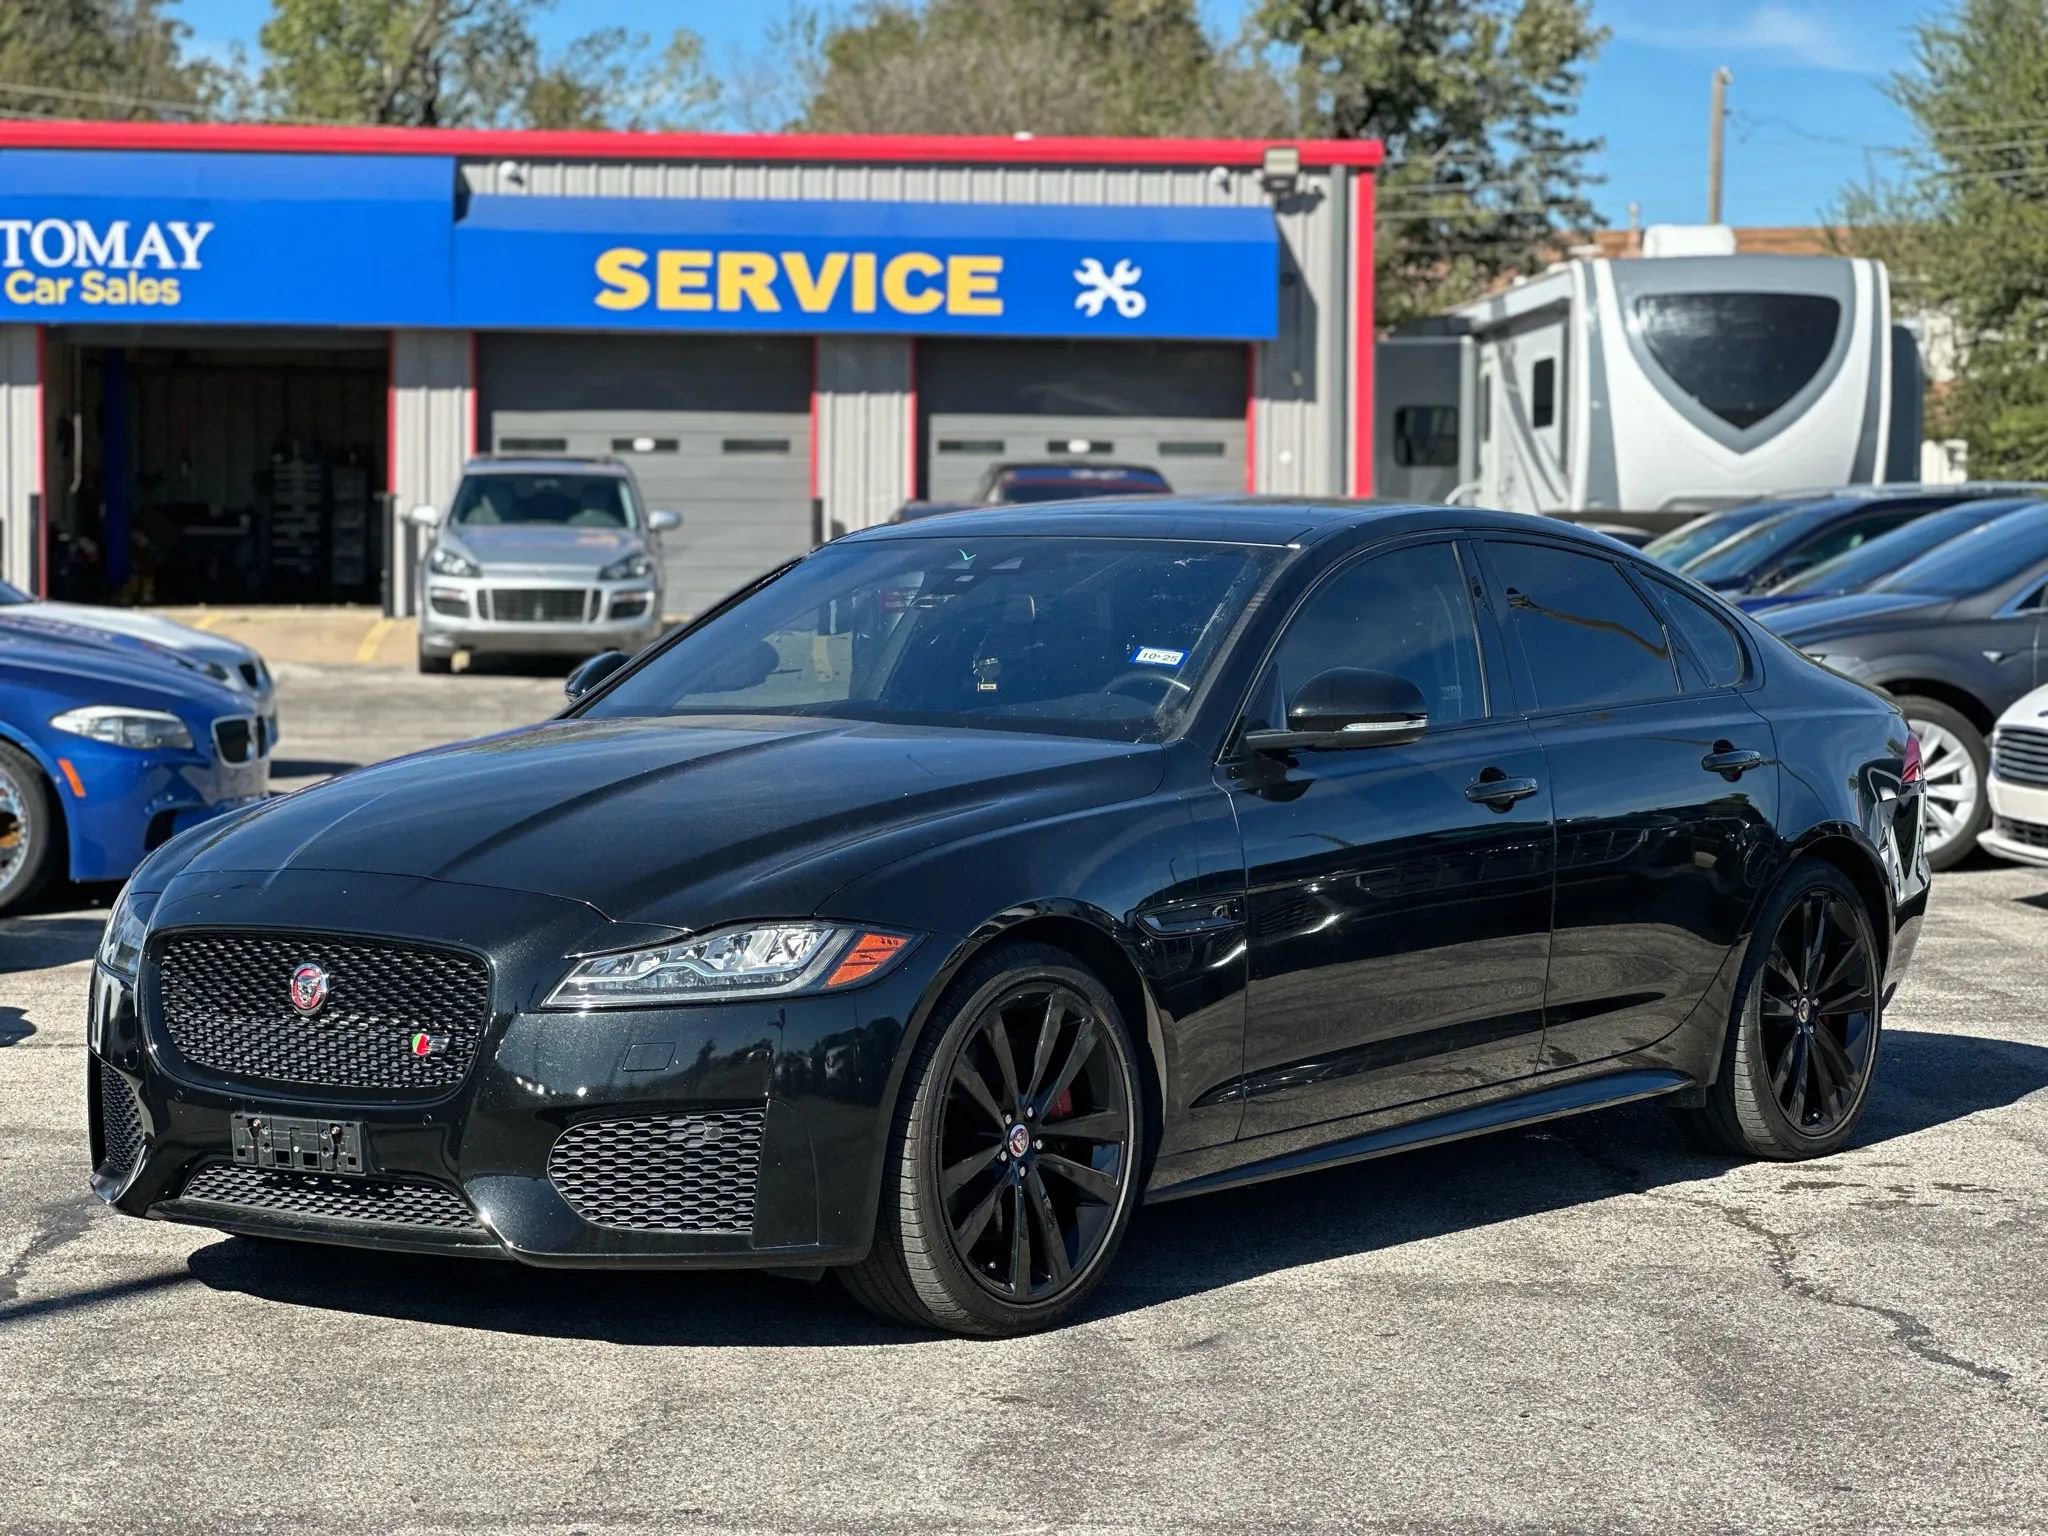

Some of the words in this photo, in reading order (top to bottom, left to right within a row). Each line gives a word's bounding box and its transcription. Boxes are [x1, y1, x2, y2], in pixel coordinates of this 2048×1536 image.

[0, 218, 215, 270] TOMAY
[5, 269, 74, 305] Car
[80, 269, 181, 306] Sales
[594, 247, 1003, 316] SERVICE
